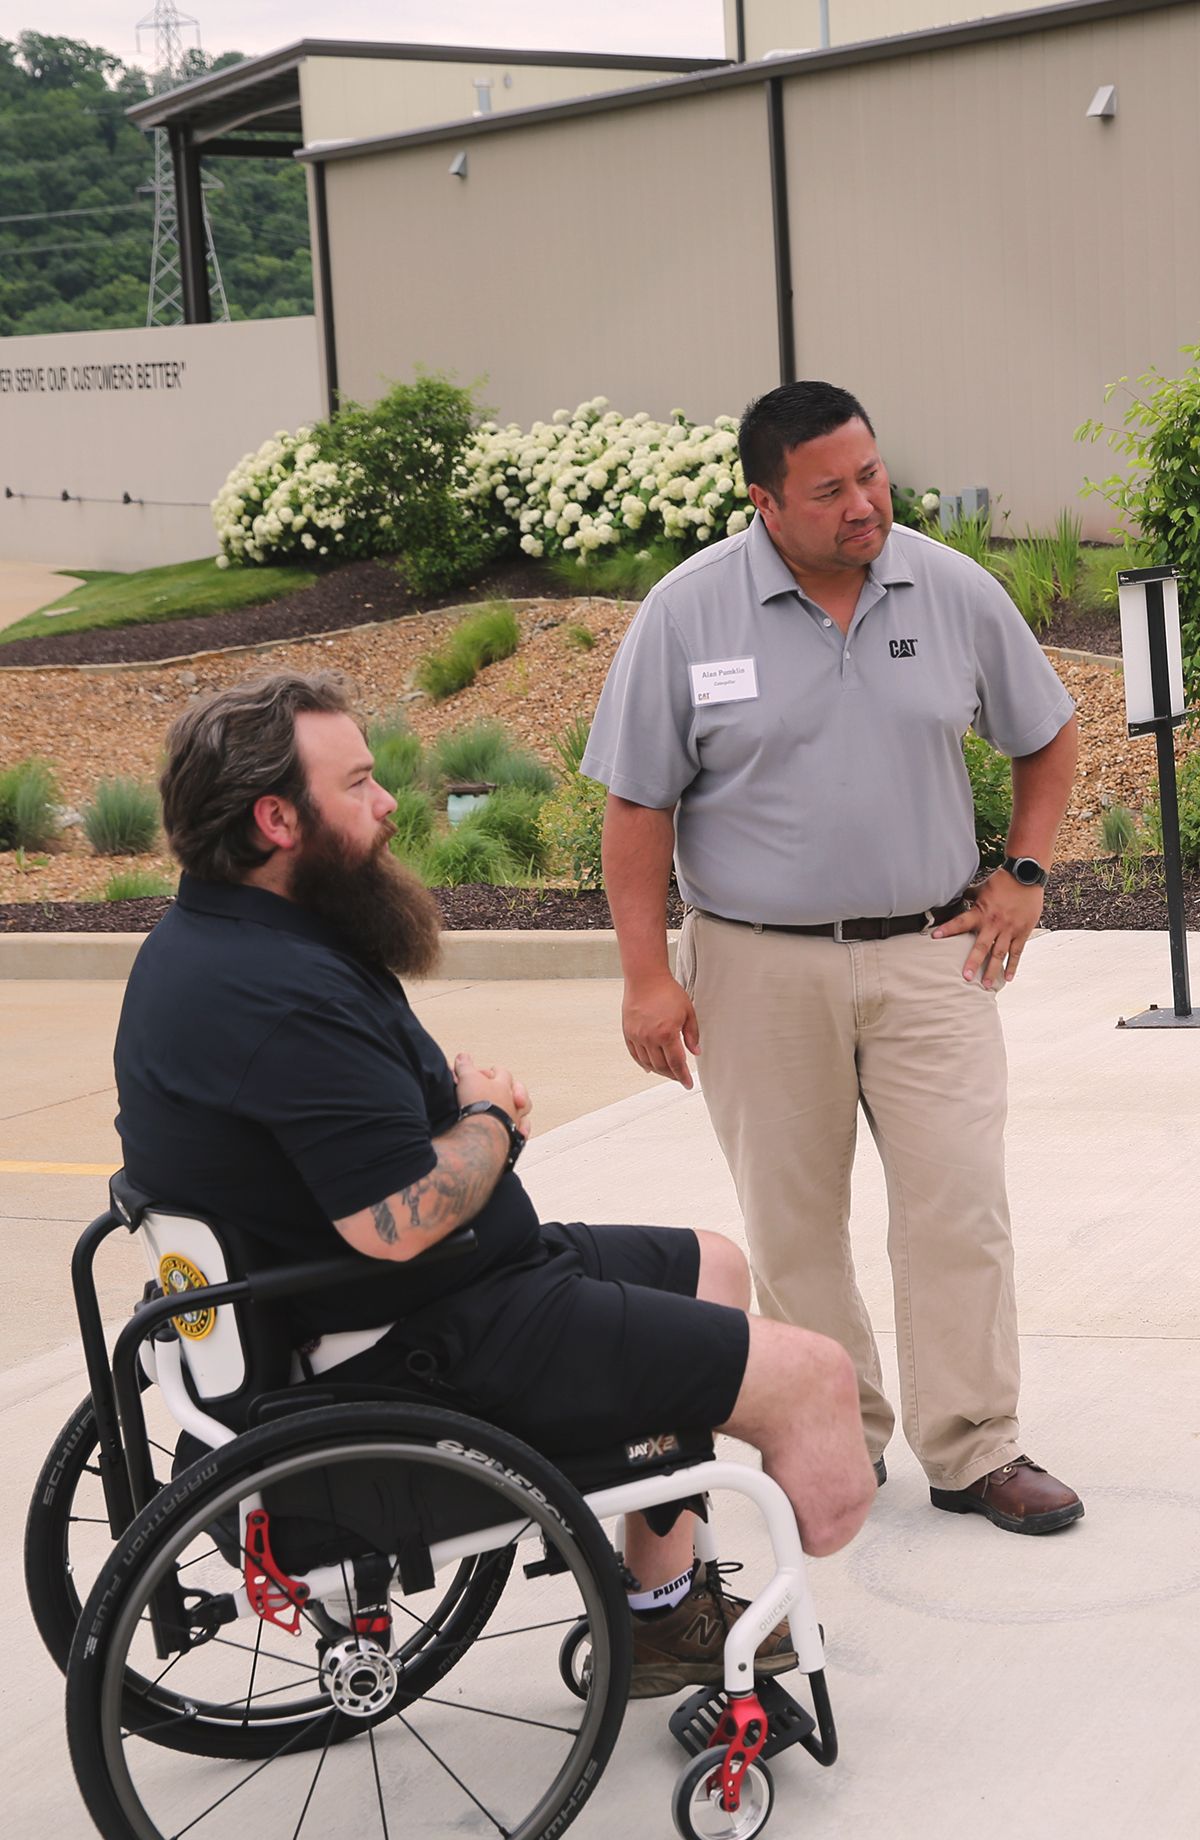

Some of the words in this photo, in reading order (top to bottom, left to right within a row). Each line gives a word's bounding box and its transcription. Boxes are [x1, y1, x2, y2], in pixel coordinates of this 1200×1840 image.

[15, 368, 45, 391] SERVE
[46, 367, 69, 391] OUR
[71, 364, 133, 391] CUSTOMERS
[889, 639, 916, 658] CAT
